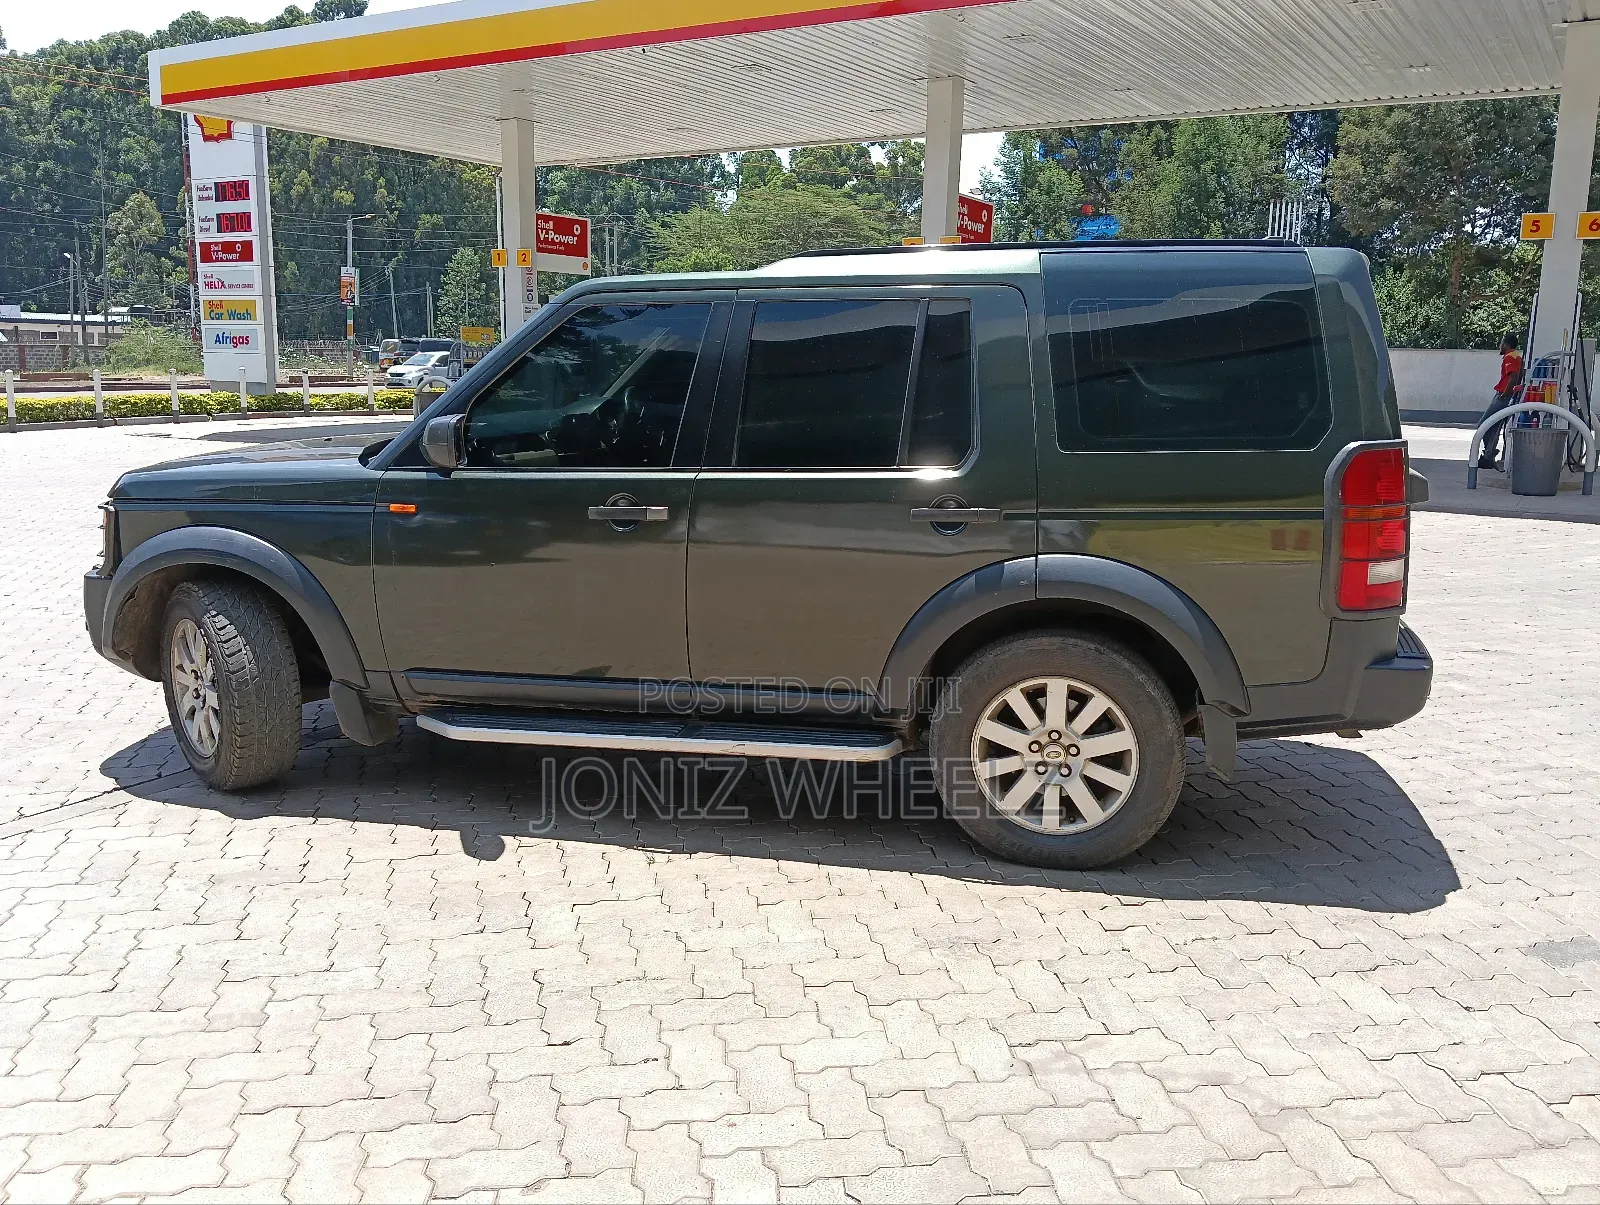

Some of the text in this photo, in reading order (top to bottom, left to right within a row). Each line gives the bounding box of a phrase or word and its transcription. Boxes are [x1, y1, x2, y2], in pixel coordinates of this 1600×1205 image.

[537, 220, 554, 229] Shell
[1530, 219, 1541, 233] 5
[1588, 218, 1600, 232] 6
[538, 229, 578, 245] V-Power
[211, 251, 240, 261] V-Power
[496, 252, 501, 262] 1
[521, 252, 527, 262] 2
[203, 280, 226, 290] HELIX
[208, 300, 224, 310] Shell
[208, 308, 252, 321] Car Wash
[214, 330, 250, 348] Afrigas
